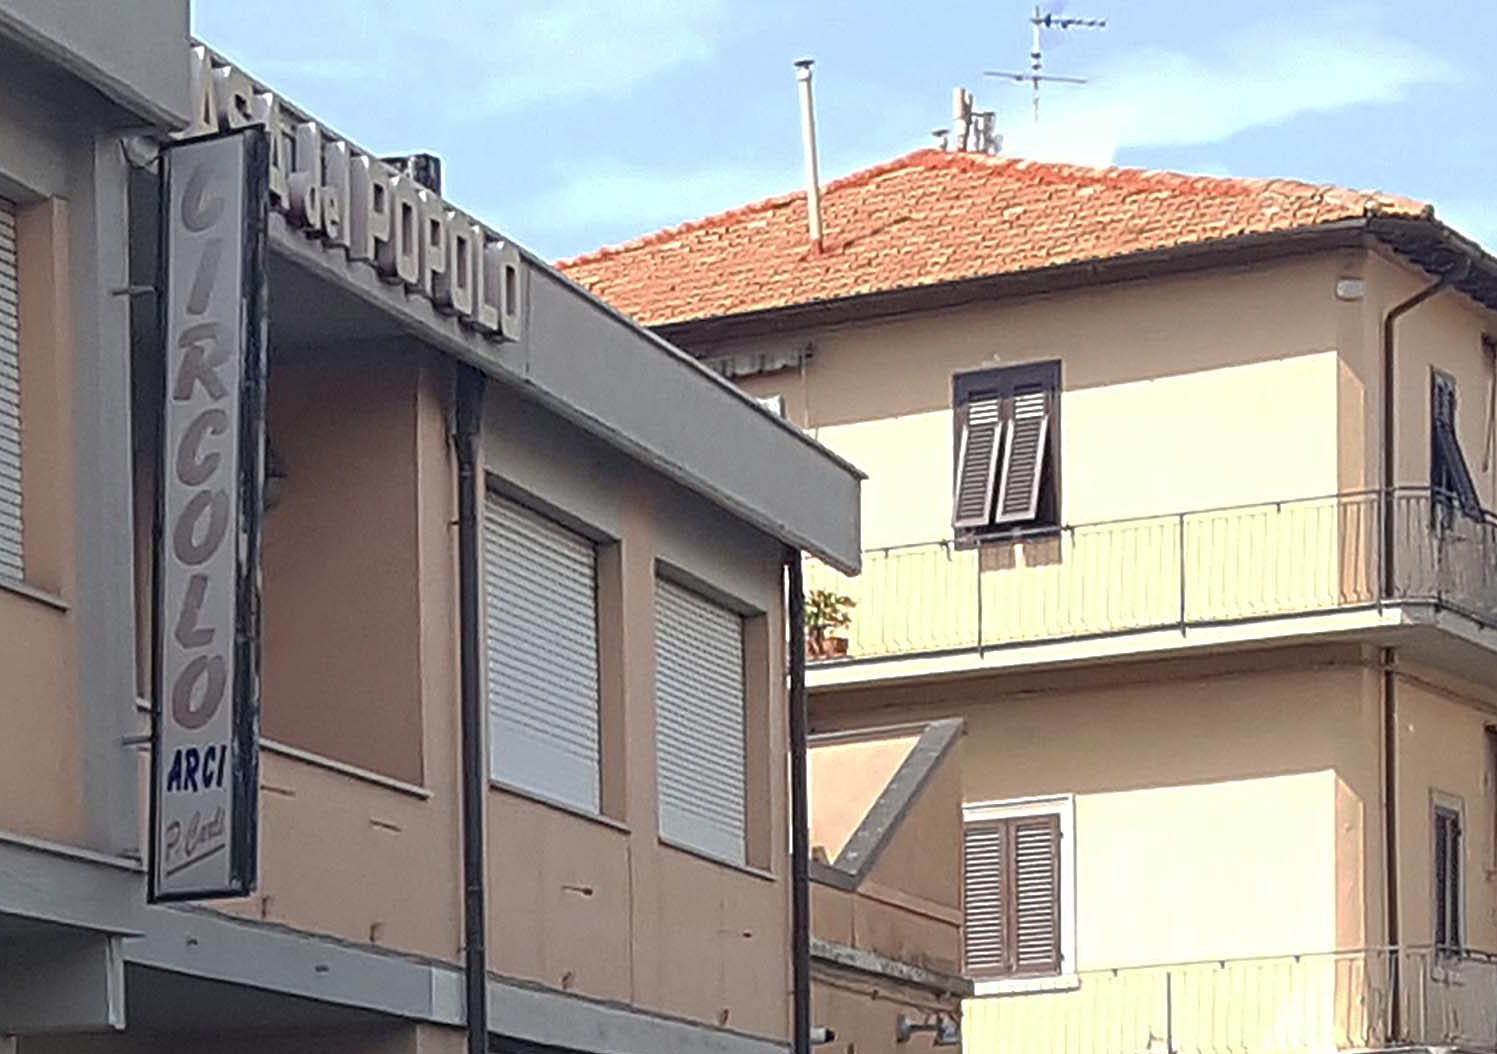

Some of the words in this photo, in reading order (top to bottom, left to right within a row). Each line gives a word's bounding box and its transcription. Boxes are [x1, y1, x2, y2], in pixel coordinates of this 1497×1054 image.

[189, 42, 291, 210] ASA
[352, 153, 521, 344] POPOLO
[171, 162, 231, 731] CIRCOLO
[166, 743, 228, 793] ARCI
